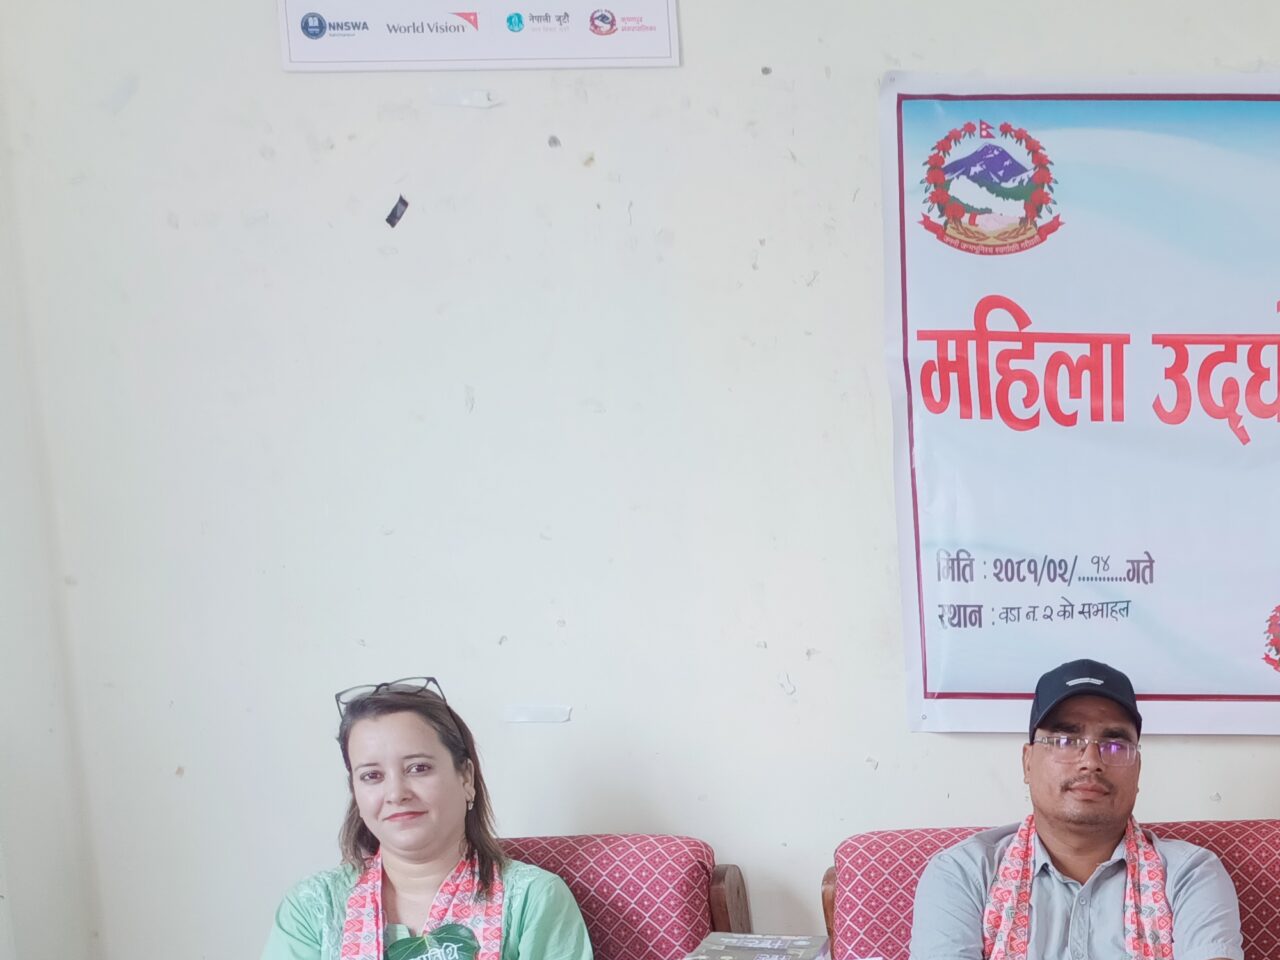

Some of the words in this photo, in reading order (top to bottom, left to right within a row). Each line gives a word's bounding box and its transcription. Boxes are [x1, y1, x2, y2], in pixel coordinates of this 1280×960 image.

[328, 21, 369, 31] NNSWA
[387, 21, 424, 34] World
[427, 20, 466, 33] Vision
[917, 294, 1131, 431] महिला
[936, 548, 975, 583] मिति
[938, 603, 983, 629] स्थान
